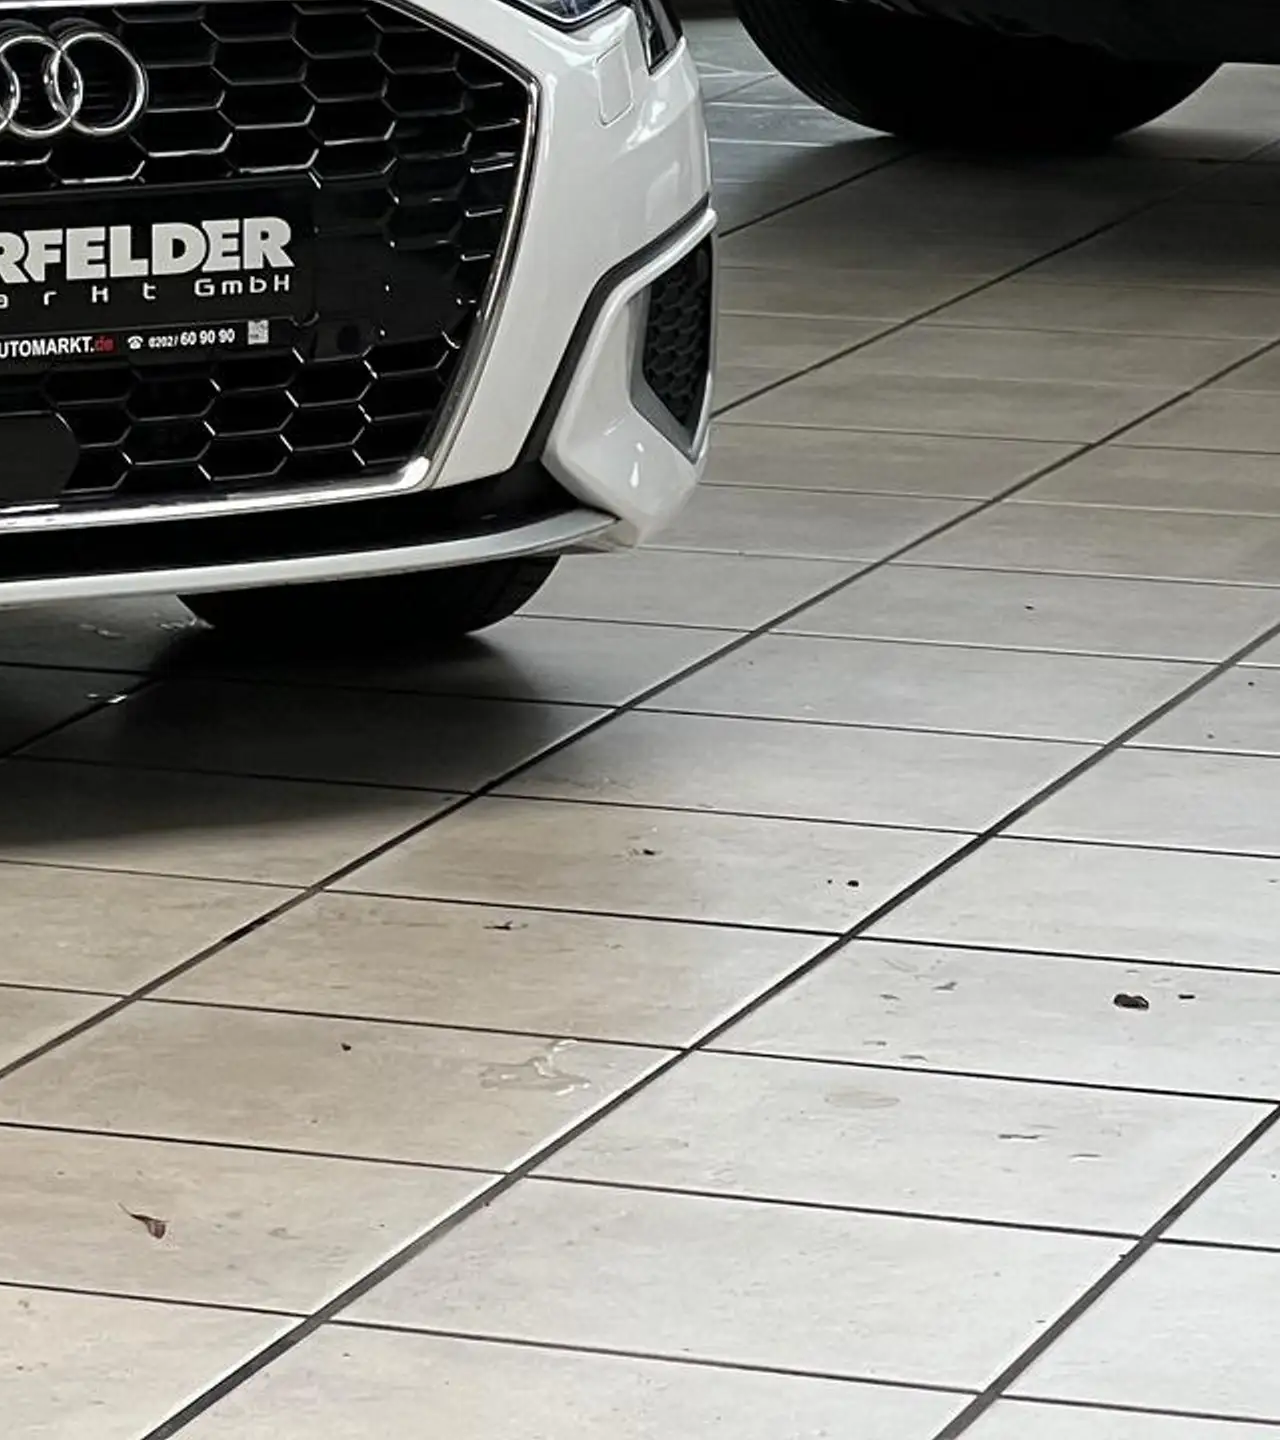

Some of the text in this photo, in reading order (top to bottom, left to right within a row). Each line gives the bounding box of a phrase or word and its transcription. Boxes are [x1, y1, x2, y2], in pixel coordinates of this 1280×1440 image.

[194, 274, 290, 297] GmbH
[180, 331, 197, 346] 60
[199, 329, 216, 345] 90
